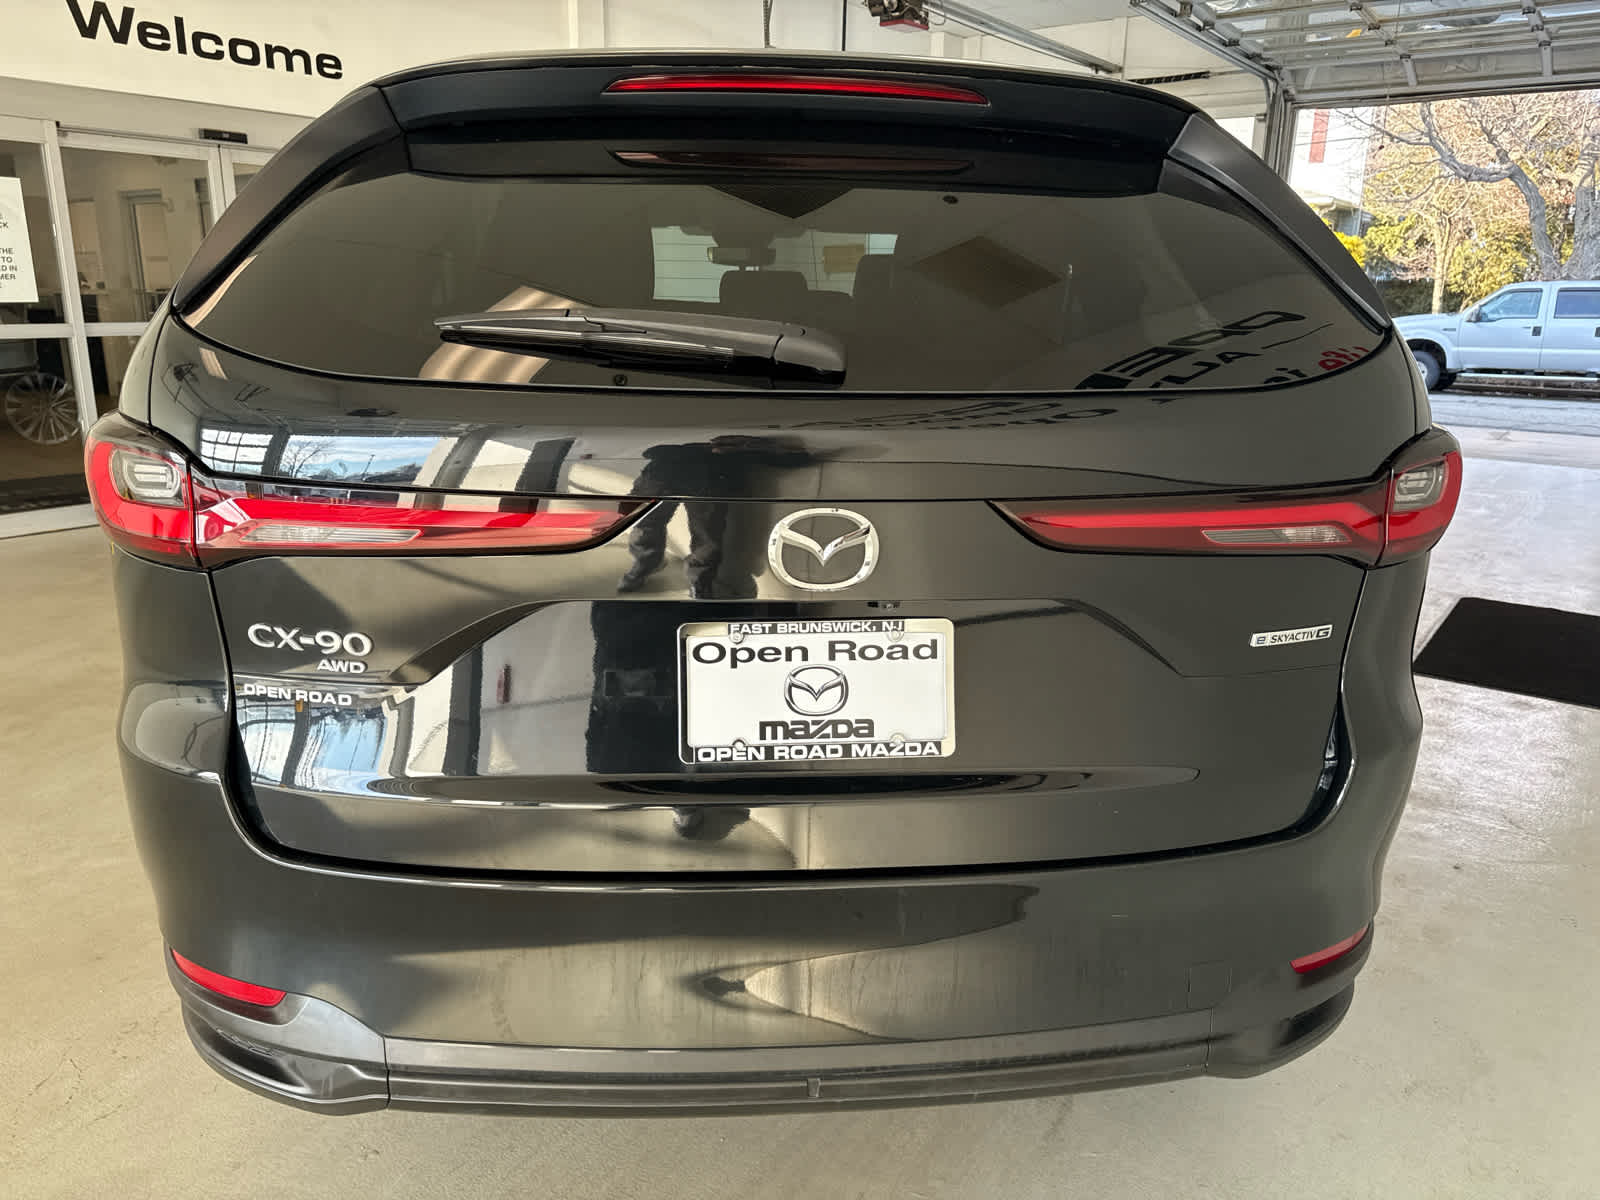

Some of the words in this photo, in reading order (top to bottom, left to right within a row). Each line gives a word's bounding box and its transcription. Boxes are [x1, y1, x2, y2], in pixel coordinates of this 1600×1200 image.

[66, 0, 343, 80] Welcome
[776, 621, 877, 634] BRUNSWICK,
[247, 622, 373, 657] CX-90
[692, 641, 809, 669] Open
[828, 639, 938, 662] Road
[317, 658, 367, 674] AWD
[243, 683, 292, 700] OPEN
[295, 689, 353, 706] ROAD
[697, 745, 766, 762] OPEN
[773, 744, 843, 761] ROAD
[851, 741, 940, 759] MAZDA
